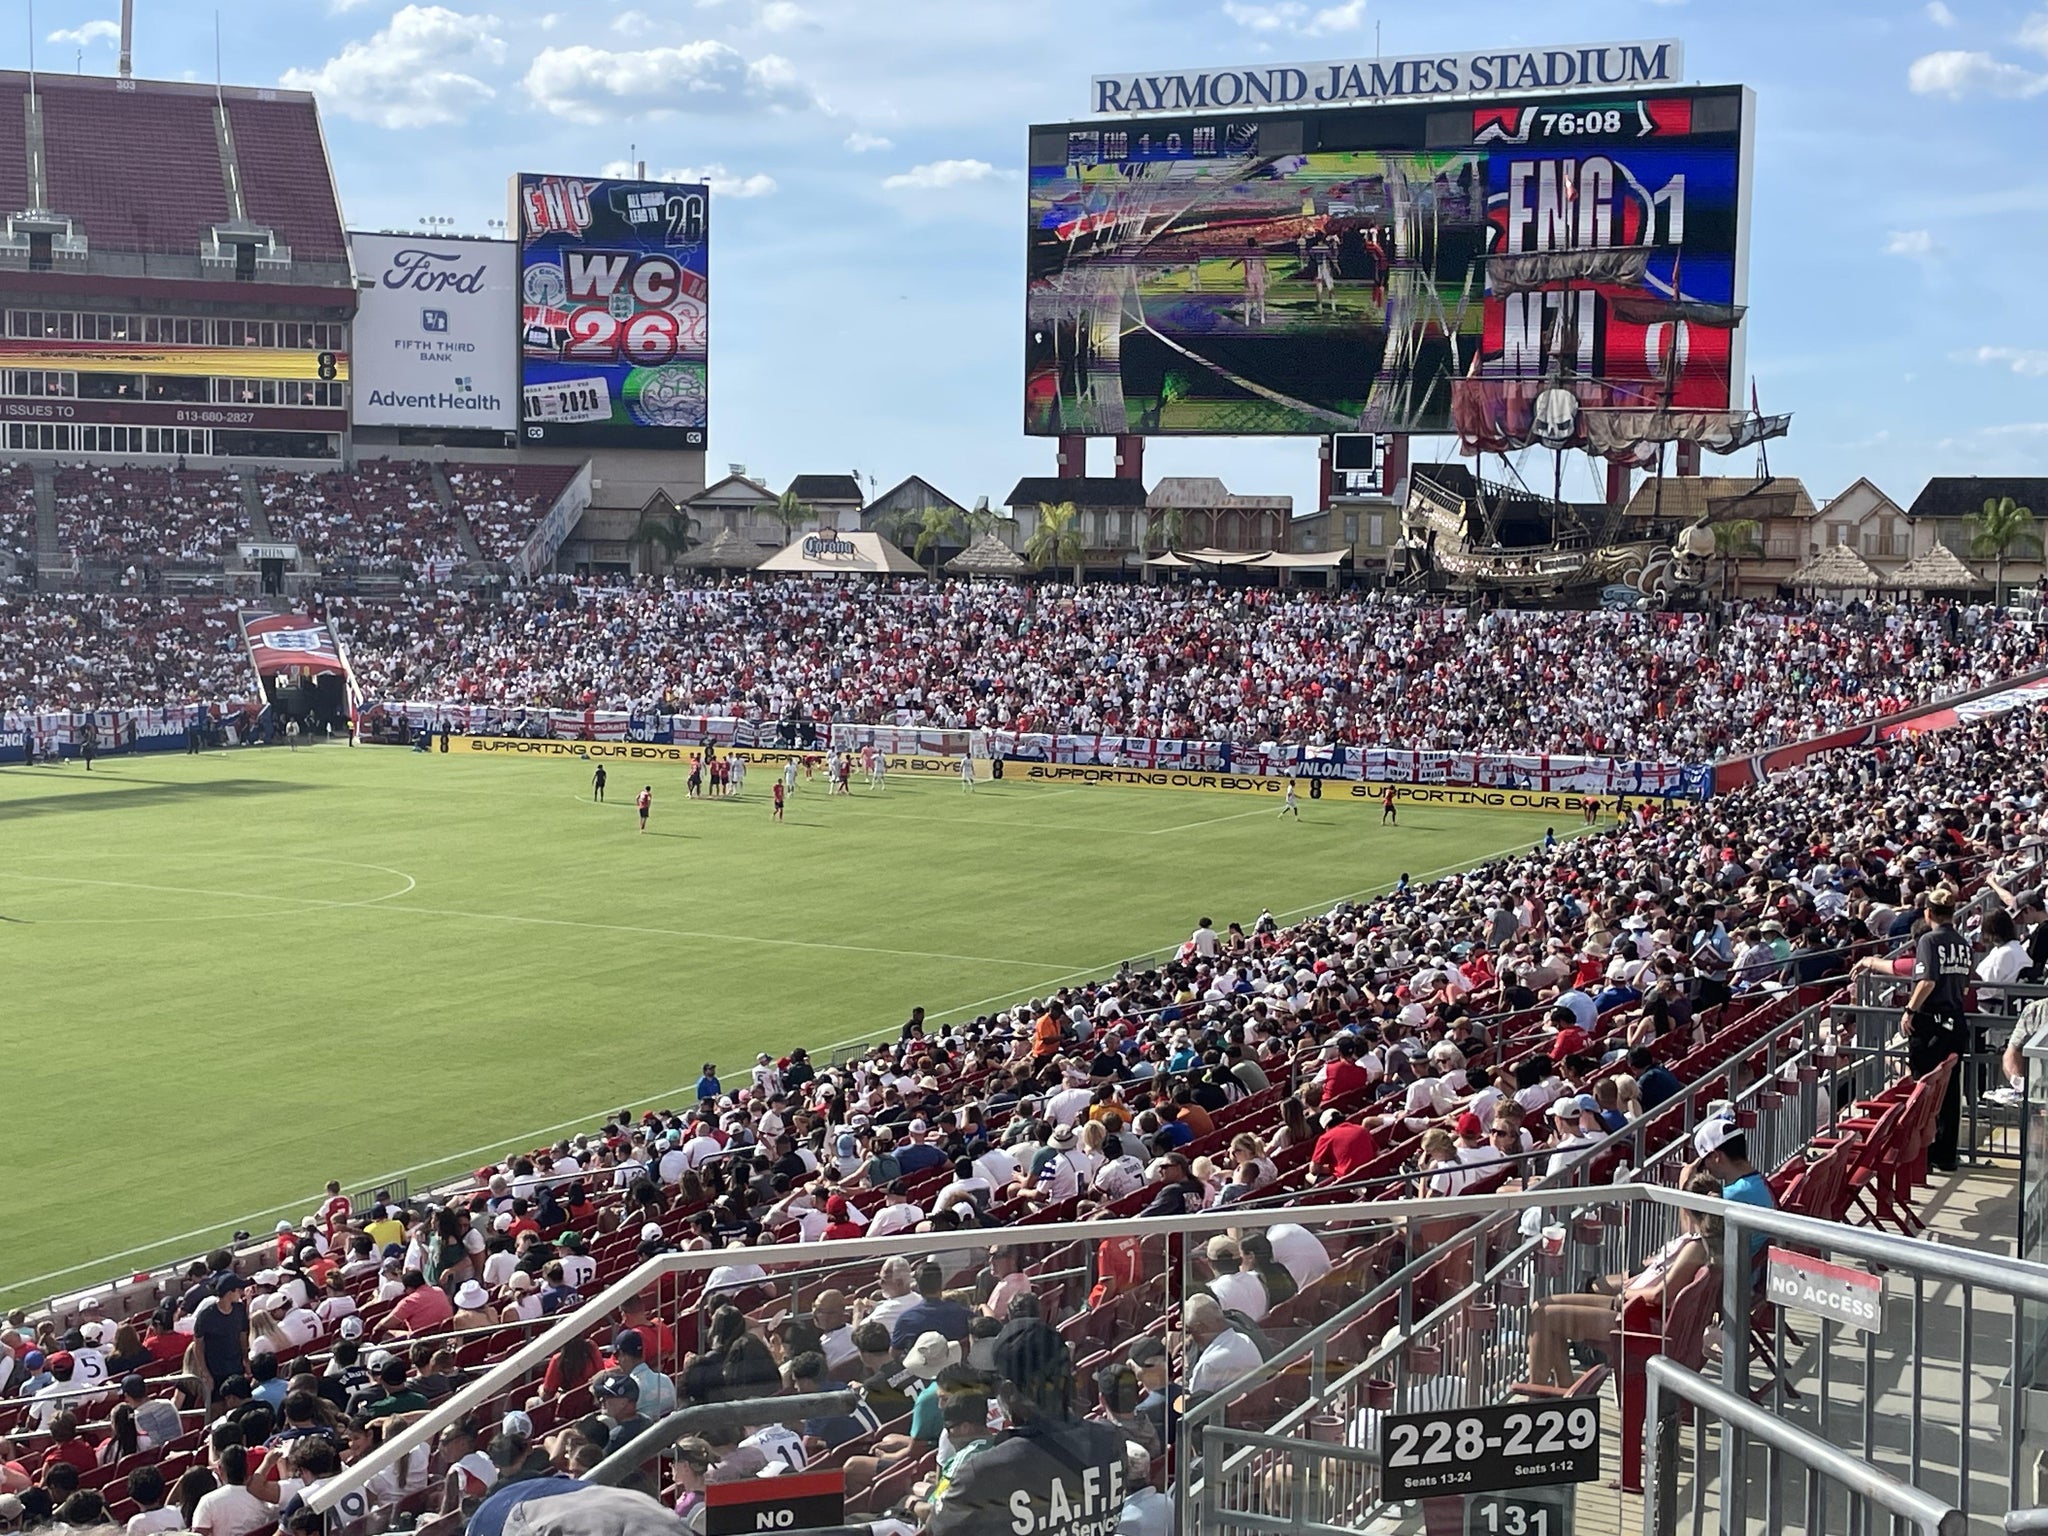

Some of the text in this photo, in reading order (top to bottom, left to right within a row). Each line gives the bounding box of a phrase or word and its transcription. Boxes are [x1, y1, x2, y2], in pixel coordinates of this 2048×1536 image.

[1096, 43, 1671, 112] RAYMOND JAMES STADIUM
[1541, 110, 1621, 136] 76:08
[523, 180, 592, 235] ENG
[1508, 156, 1614, 254] ENG
[1654, 173, 1685, 245] 1
[665, 194, 704, 248] 26
[383, 249, 487, 295] Ford
[568, 254, 675, 304] WC
[395, 340, 475, 353] FIFTH THIRD
[571, 310, 673, 359] 26
[420, 352, 452, 363] BANK
[1645, 320, 1689, 380] 0
[5, 404, 74, 417] ISSUES TO
[560, 389, 599, 413] 2026
[176, 411, 254, 424] 813-680-2827
[803, 536, 854, 557] Corona
[472, 740, 680, 760] SUPPORTING OUR BOYS
[1032, 766, 1280, 792] SUPPORTING OUR BOYS
[1351, 786, 1504, 806] SUPORTING
[1511, 794, 1560, 809] OUR
[576, 1268, 593, 1286] 12
[1772, 1277, 1875, 1320] NO ACCESS
[307, 1324, 317, 1338] 7
[81, 1356, 101, 1378] 5
[1389, 1408, 1596, 1467] 228-229
[777, 1441, 807, 1467] 11
[1404, 1471, 1472, 1488] Seats 13-24
[1515, 1460, 1573, 1476] Seats 1-12
[756, 1509, 794, 1530] NO
[1480, 1502, 1548, 1536] 131
